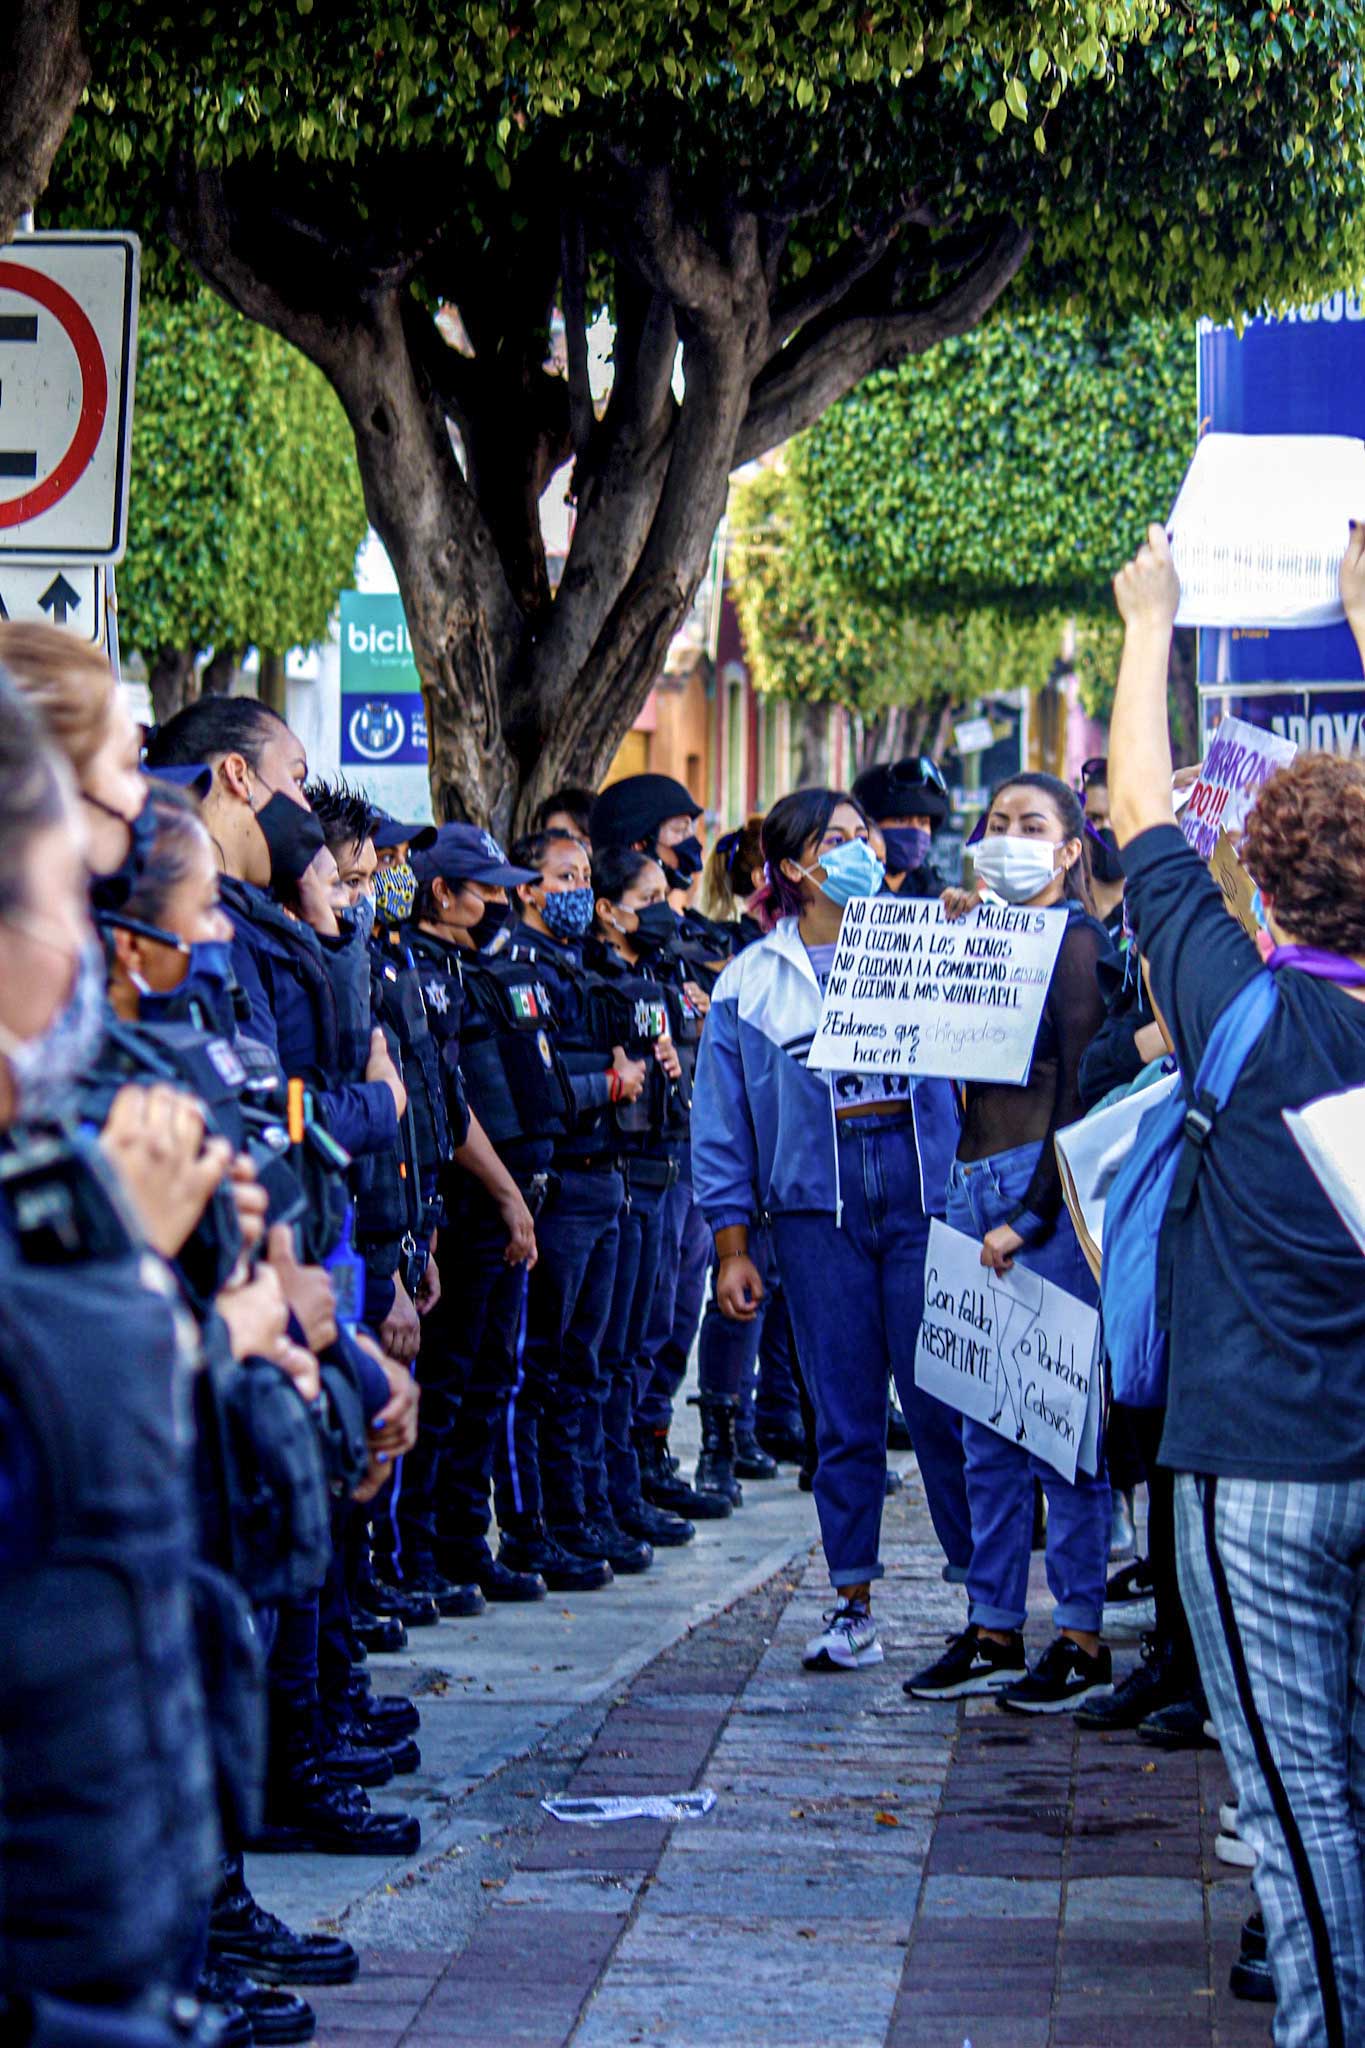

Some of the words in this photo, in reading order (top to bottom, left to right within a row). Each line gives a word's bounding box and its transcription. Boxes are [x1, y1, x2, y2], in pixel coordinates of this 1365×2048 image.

[846, 901, 866, 924] NO
[870, 903, 917, 925] CUIDAN
[919, 904, 930, 925] A
[935, 905, 966, 926] LS
[976, 906, 1045, 933] MUJERES
[841, 926, 862, 947] NO
[865, 928, 911, 953] CUIDAN
[913, 933, 924, 953] A
[929, 934, 955, 956] LOS
[835, 952, 855, 972] NO
[858, 955, 903, 977] CUIDAN
[903, 957, 913, 977] A
[916, 957, 932, 977] LA
[935, 958, 1007, 981] COMUNIDAD
[829, 976, 847, 996] NO
[851, 978, 896, 1000] CUIDAN
[898, 980, 910, 1000] AL
[926, 1268, 955, 1316] Con
[958, 1289, 992, 1337] falda
[921, 1320, 992, 1385] RESPETAME
